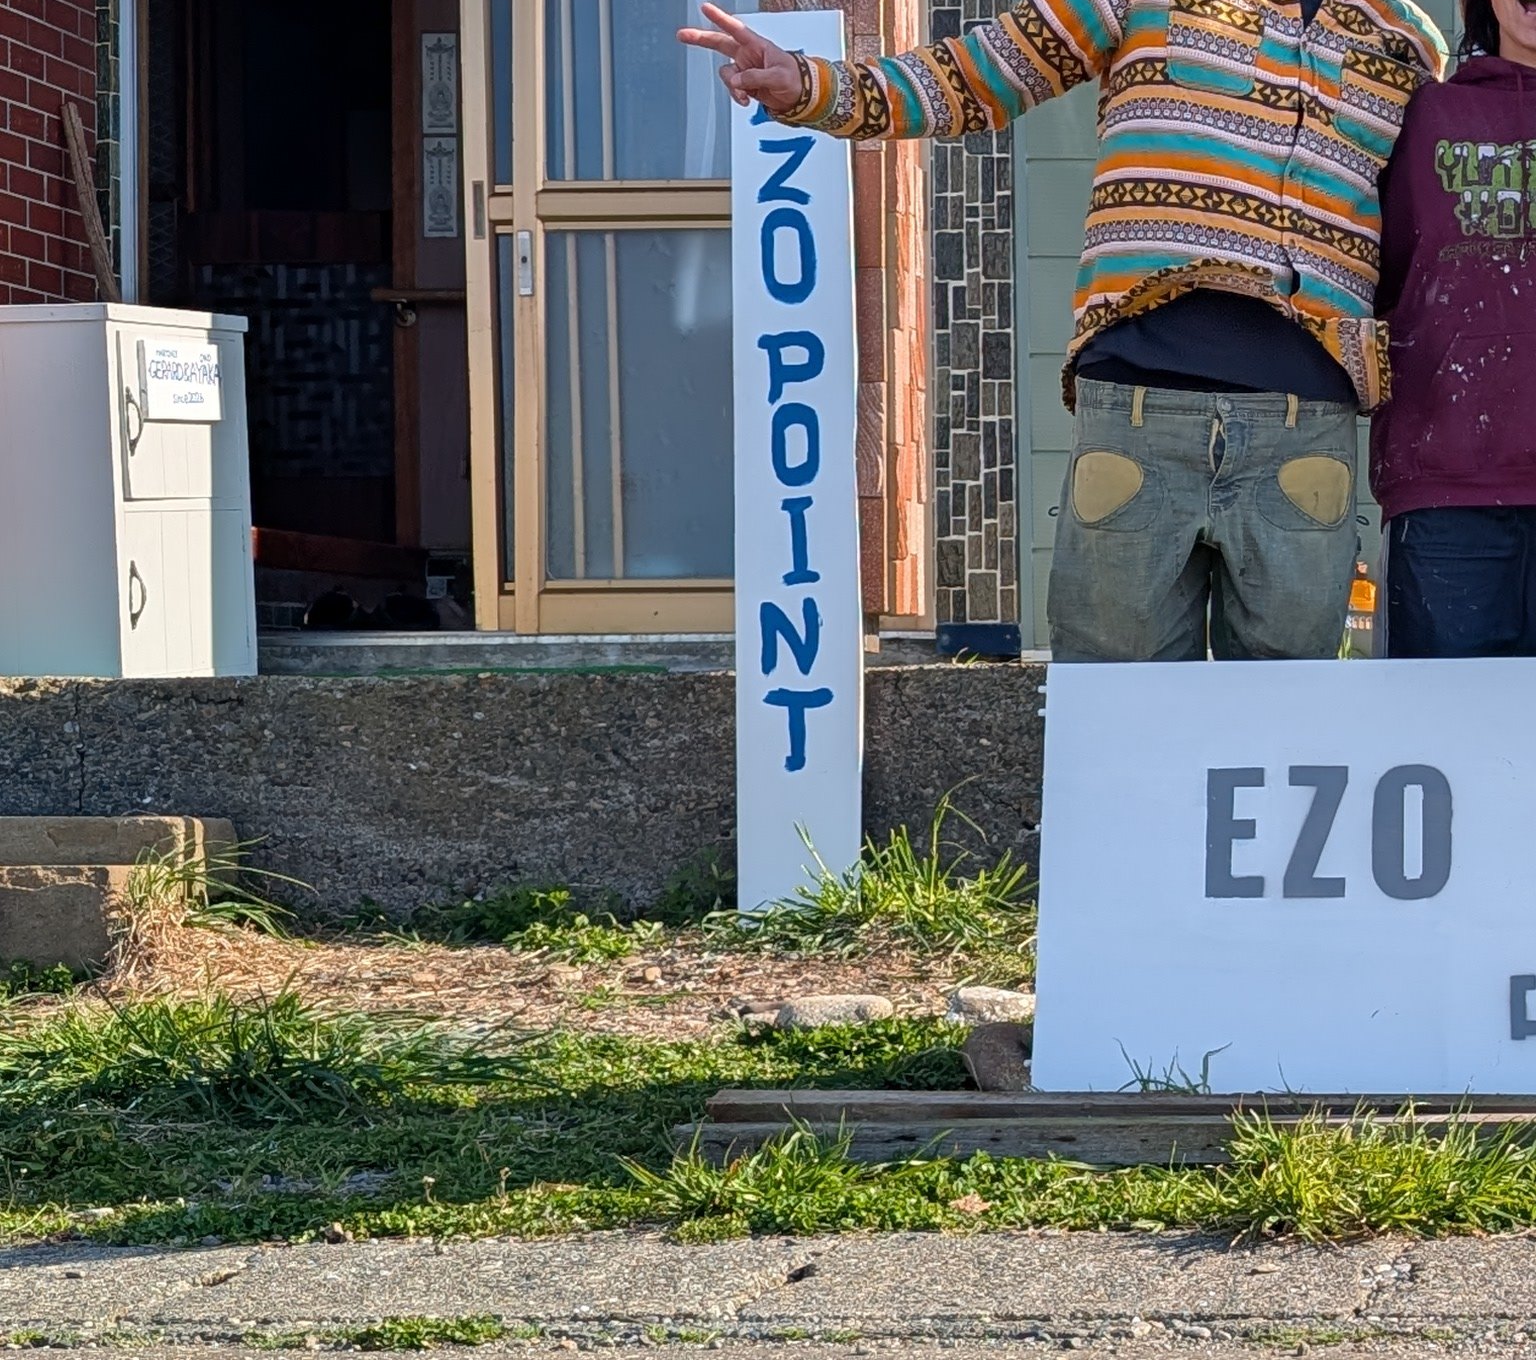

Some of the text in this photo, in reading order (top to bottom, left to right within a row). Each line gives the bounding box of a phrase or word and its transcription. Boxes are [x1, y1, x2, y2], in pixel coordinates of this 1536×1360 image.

[750, 48, 834, 772] ZO POINT
[1204, 763, 1454, 901] EZO
